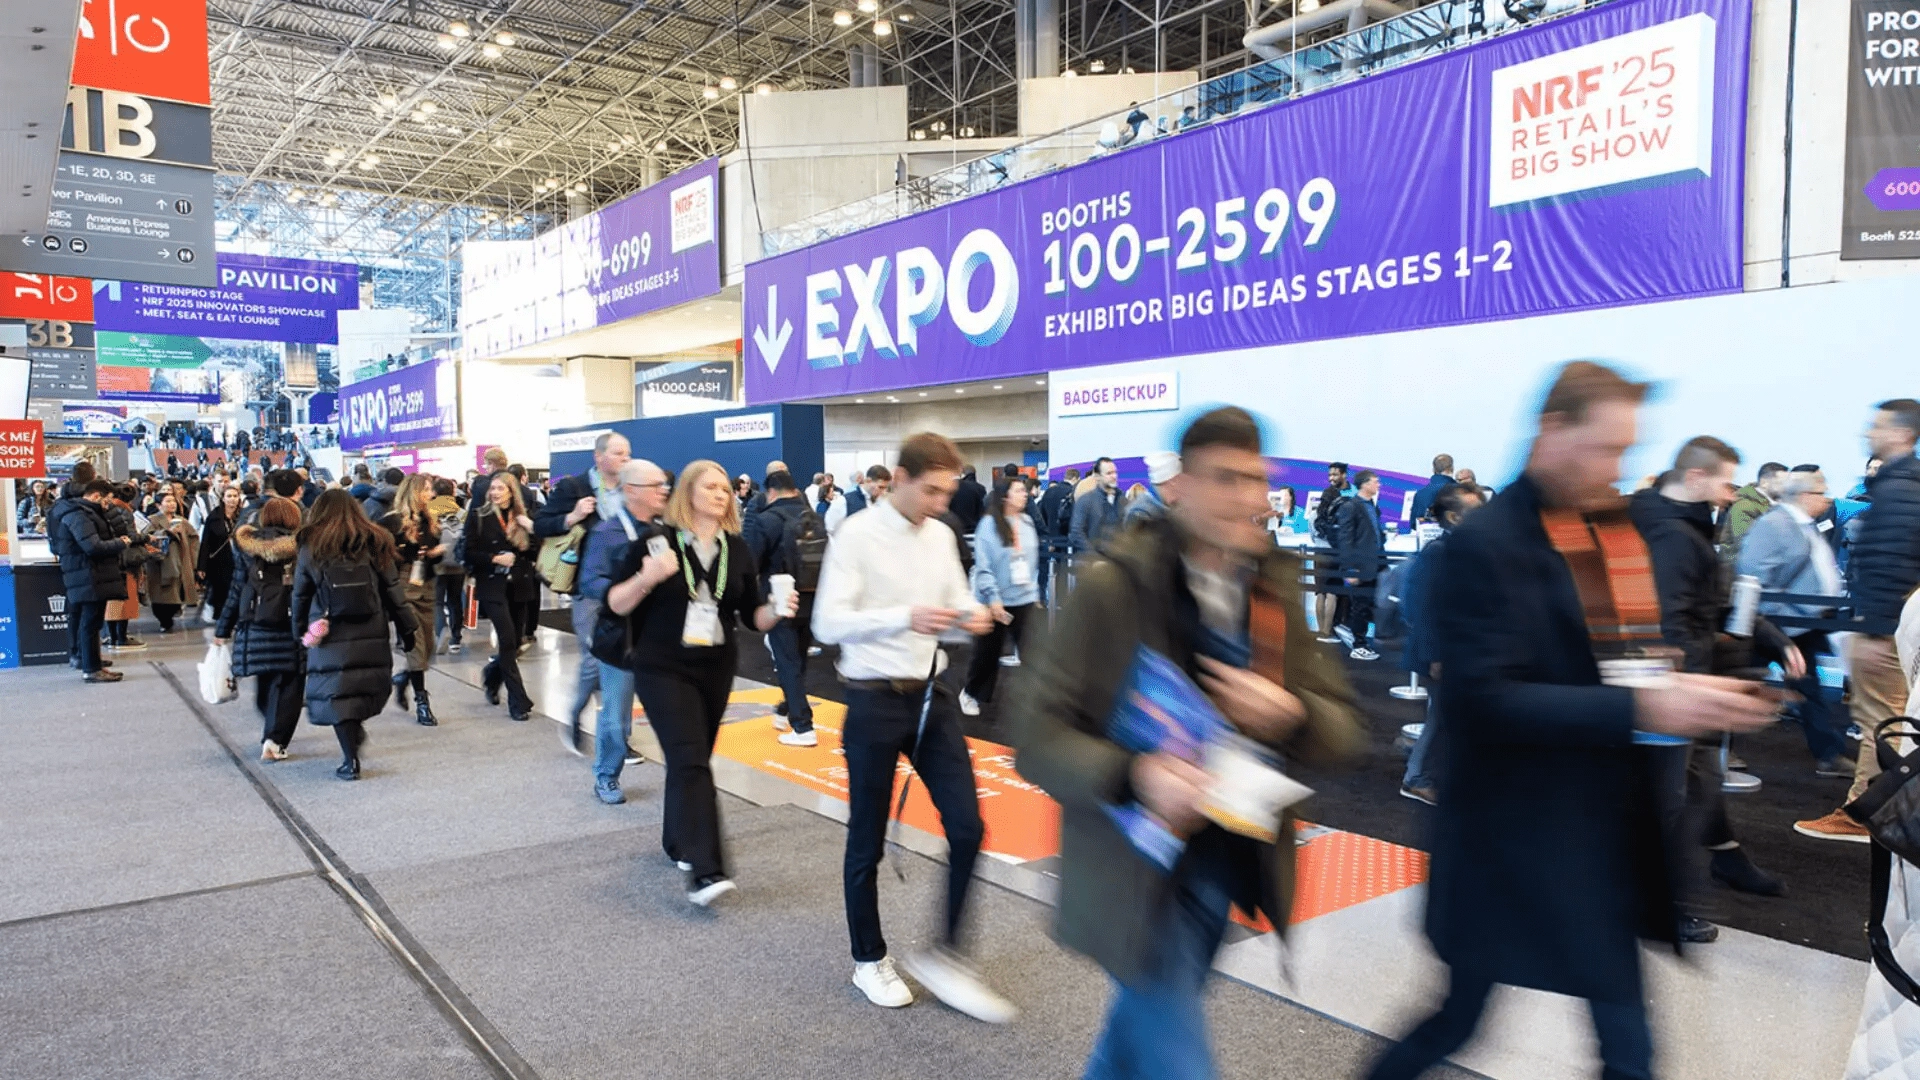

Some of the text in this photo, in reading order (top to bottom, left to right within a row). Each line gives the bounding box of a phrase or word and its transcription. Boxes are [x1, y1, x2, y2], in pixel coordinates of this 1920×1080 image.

[1867, 10, 1920, 31] PRO
[1866, 38, 1920, 60] FOR
[1513, 46, 1675, 123] NRF '25
[1512, 94, 1674, 152] RETAIL'S
[1511, 125, 1672, 180] BIG SHOW
[69, 164, 89, 178] 1E,
[92, 167, 113, 181] 2D,
[116, 170, 137, 184] 3D,
[139, 173, 156, 185] 3E
[75, 190, 123, 205] Pavilion
[86, 214, 131, 225] American
[132, 218, 170, 230] Express
[1042, 191, 1131, 235] BOOTHS
[86, 222, 131, 234] Business
[134, 227, 170, 239] Lounge
[1043, 177, 1338, 294] 100-2599
[1861, 231, 1895, 241] Booth
[142, 284, 244, 301] RETURNPRO STAGE
[221, 268, 337, 294] PAVILION
[612, 282, 634, 301] IDEAS
[635, 273, 664, 294] STAGES
[1045, 240, 1513, 338] EXHIBITOR BIG IDEAS STAGES 1-2
[142, 296, 327, 319] NRF 2025 INNOVATORS SHOWCASE
[806, 229, 1018, 369] EXPO
[143, 308, 281, 326] MEET, SEAT & EAT LOUNGE
[27, 320, 74, 348] 3B
[688, 382, 721, 393] CASH
[1063, 383, 1168, 406] BADGE PICKUP
[350, 388, 389, 436] EXPO
[718, 420, 770, 434] INTERPRETATION
[41, 614, 69, 623] TRAS
